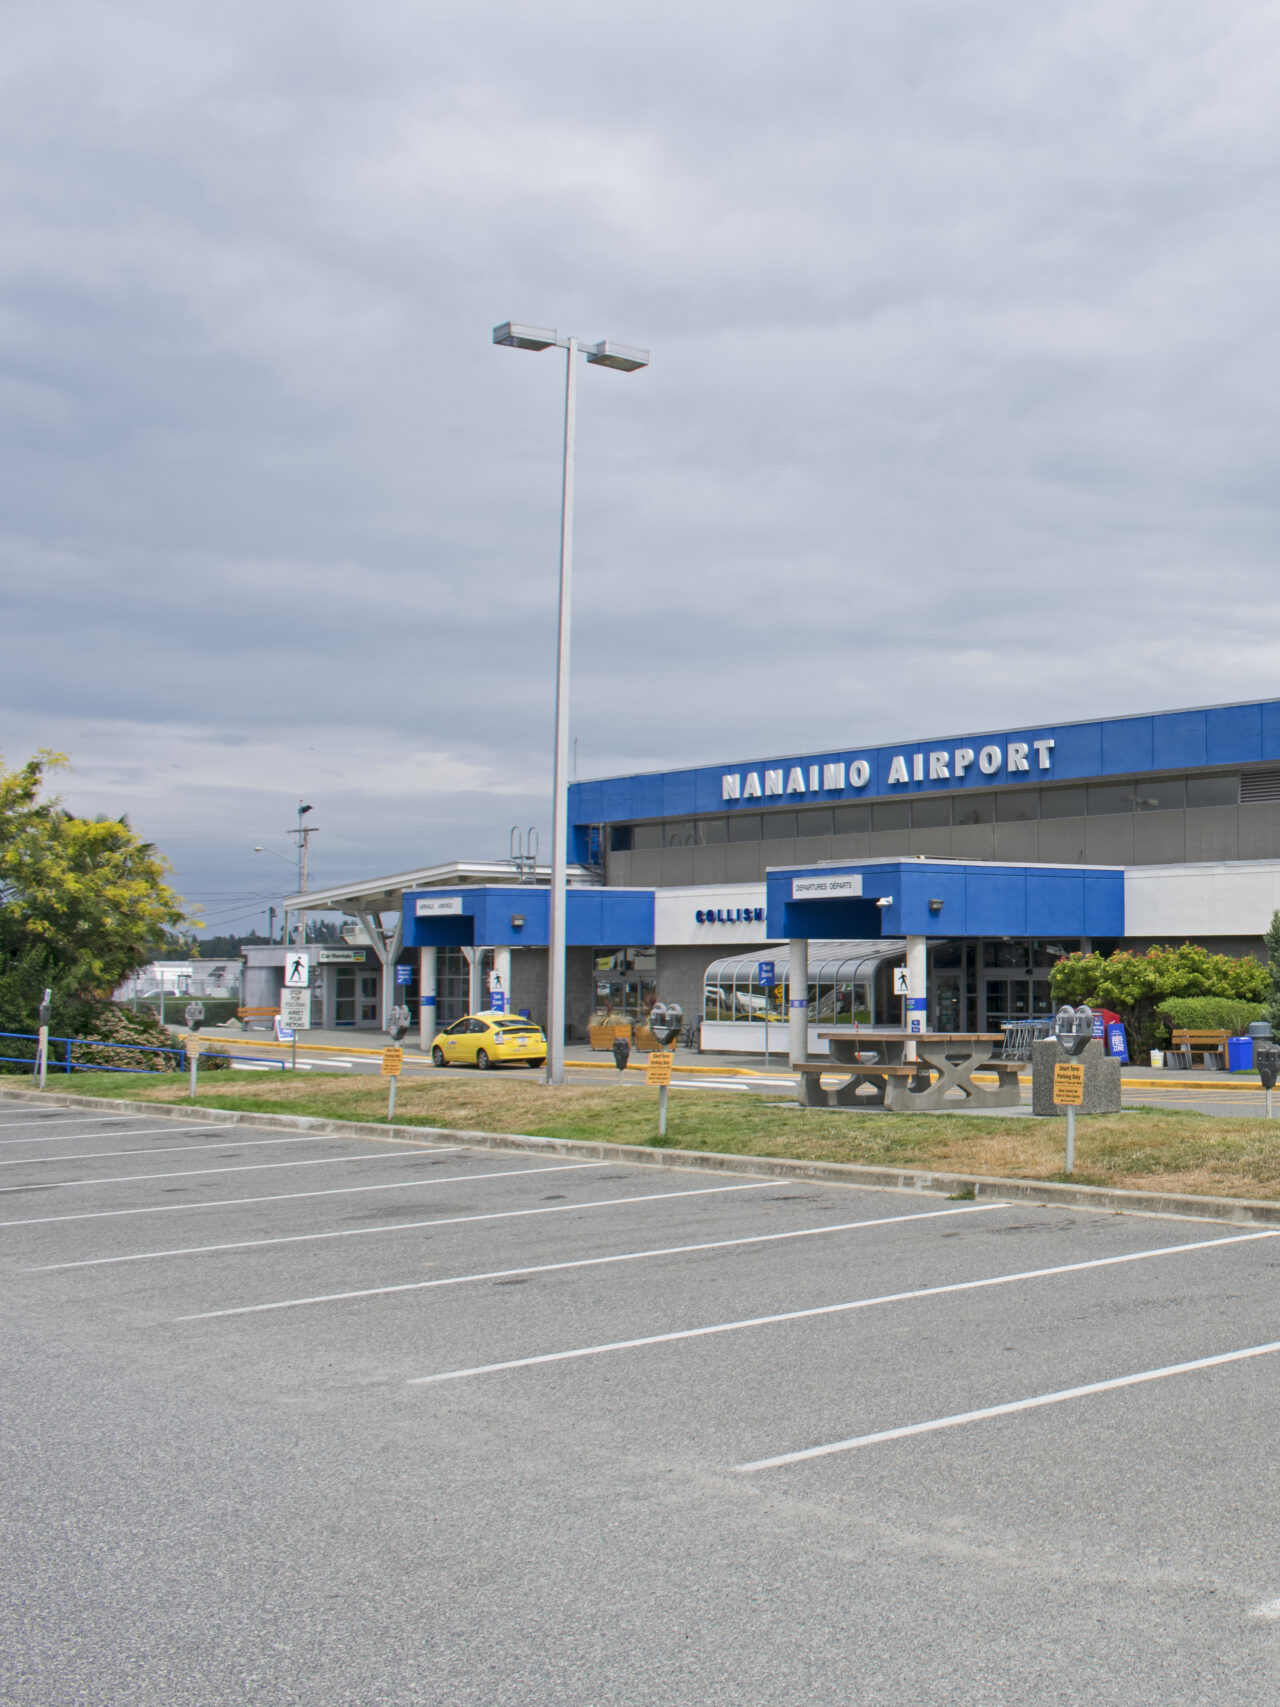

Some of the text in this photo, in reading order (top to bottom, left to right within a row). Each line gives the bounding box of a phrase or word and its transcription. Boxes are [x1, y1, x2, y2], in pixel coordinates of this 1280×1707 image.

[722, 739, 1055, 800] NANAIMO AIRPORT
[796, 883, 828, 892] DEPARTURES
[695, 907, 767, 925] COLLISH
